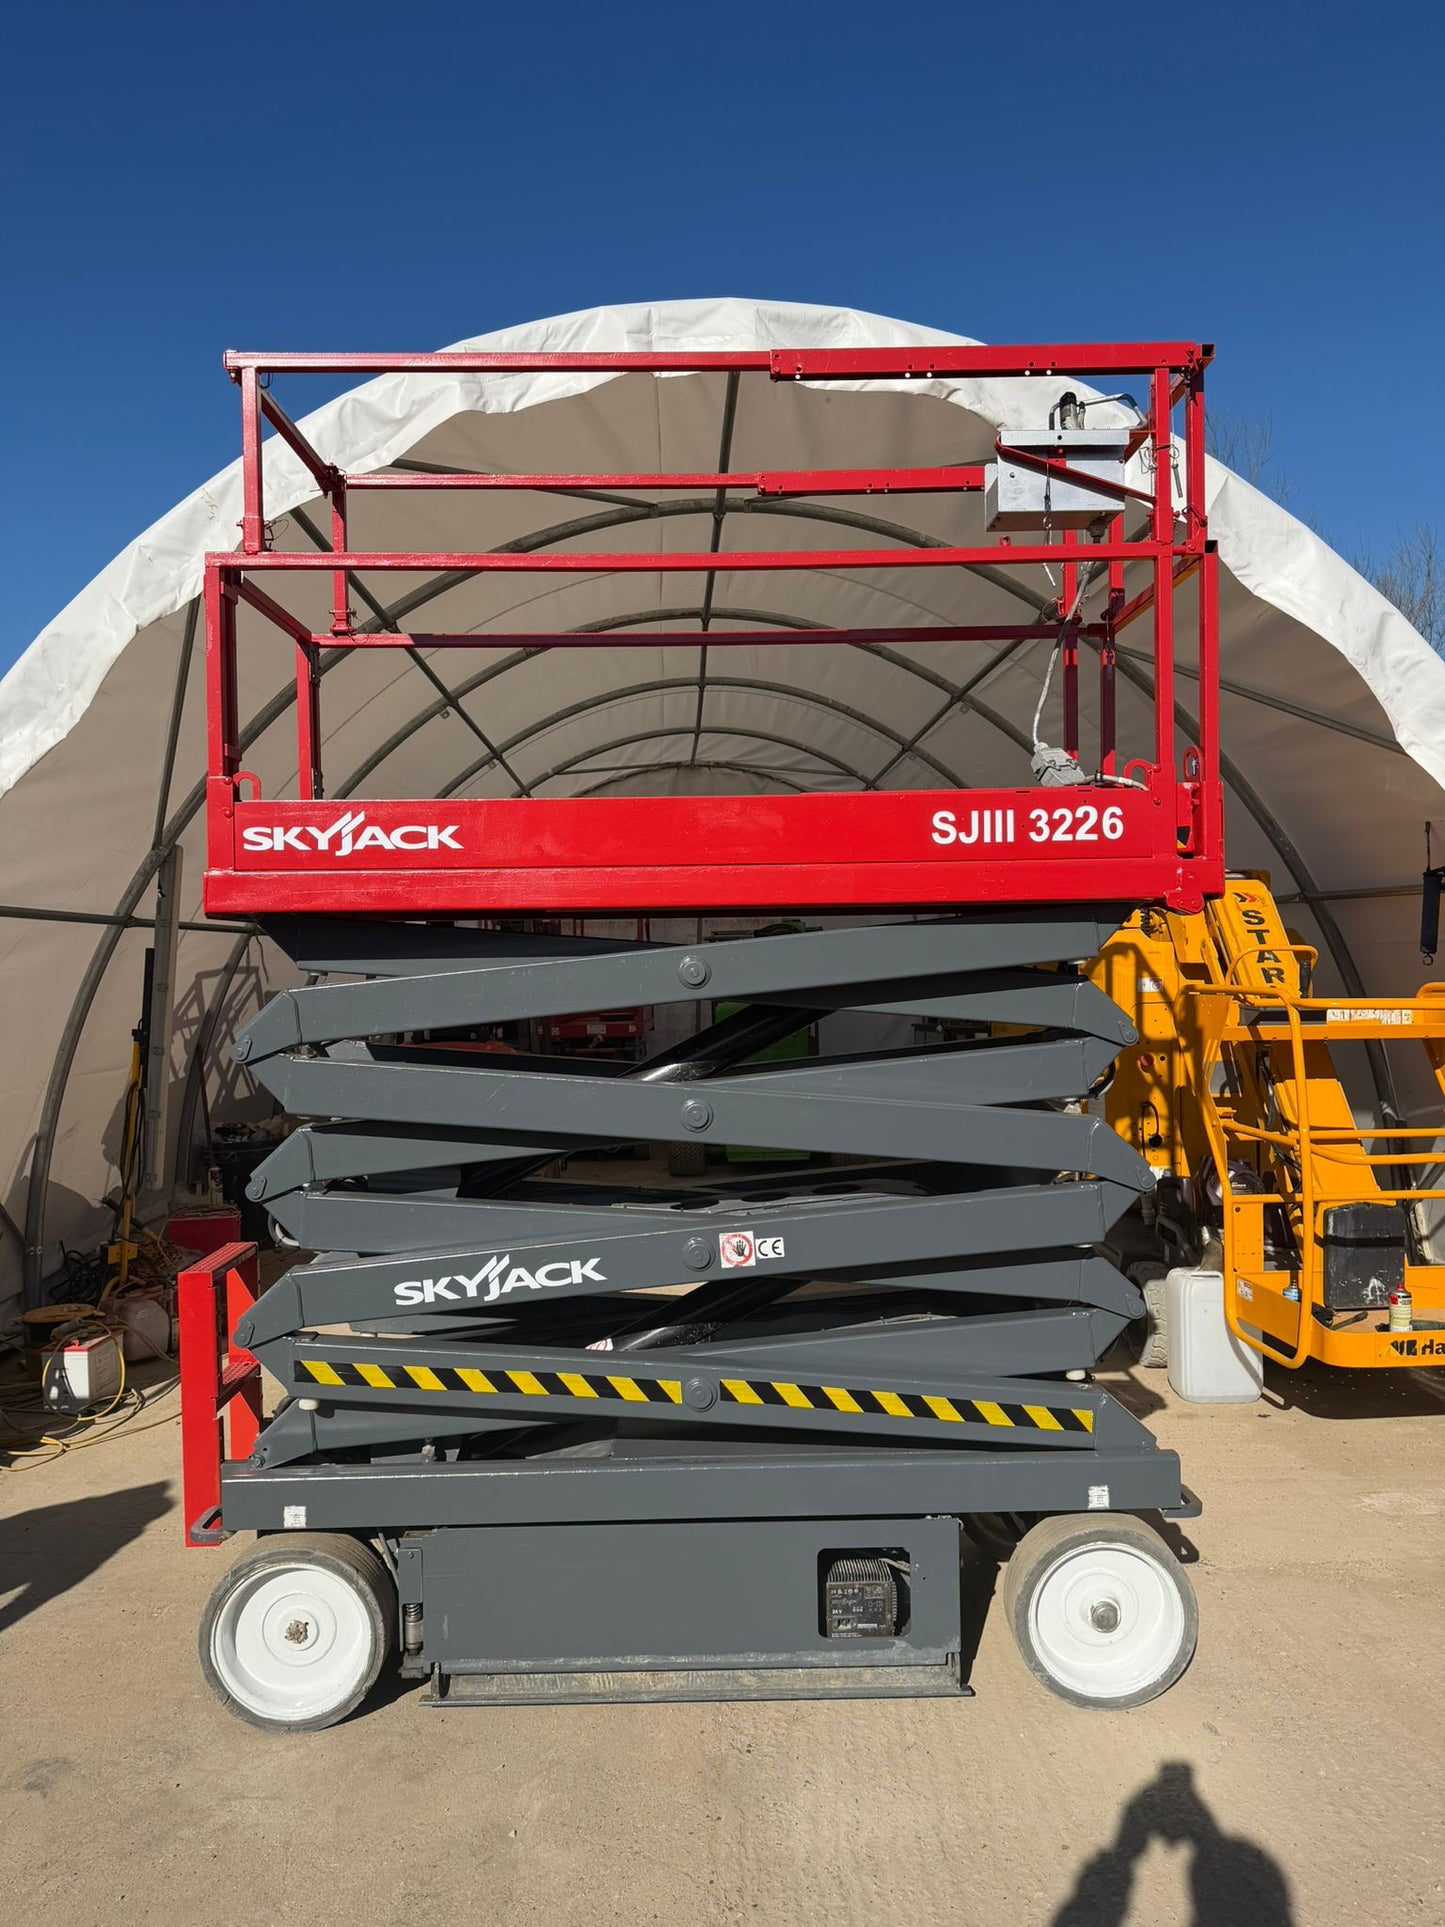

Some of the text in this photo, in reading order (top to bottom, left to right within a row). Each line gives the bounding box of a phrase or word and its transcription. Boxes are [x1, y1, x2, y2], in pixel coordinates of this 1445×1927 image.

[242, 810, 465, 857] SKYJACK
[931, 805, 1125, 845] SJIII 3226
[1241, 909, 1286, 984] STAR
[757, 1238, 782, 1257] CE
[393, 1253, 608, 1306] SKYJACK
